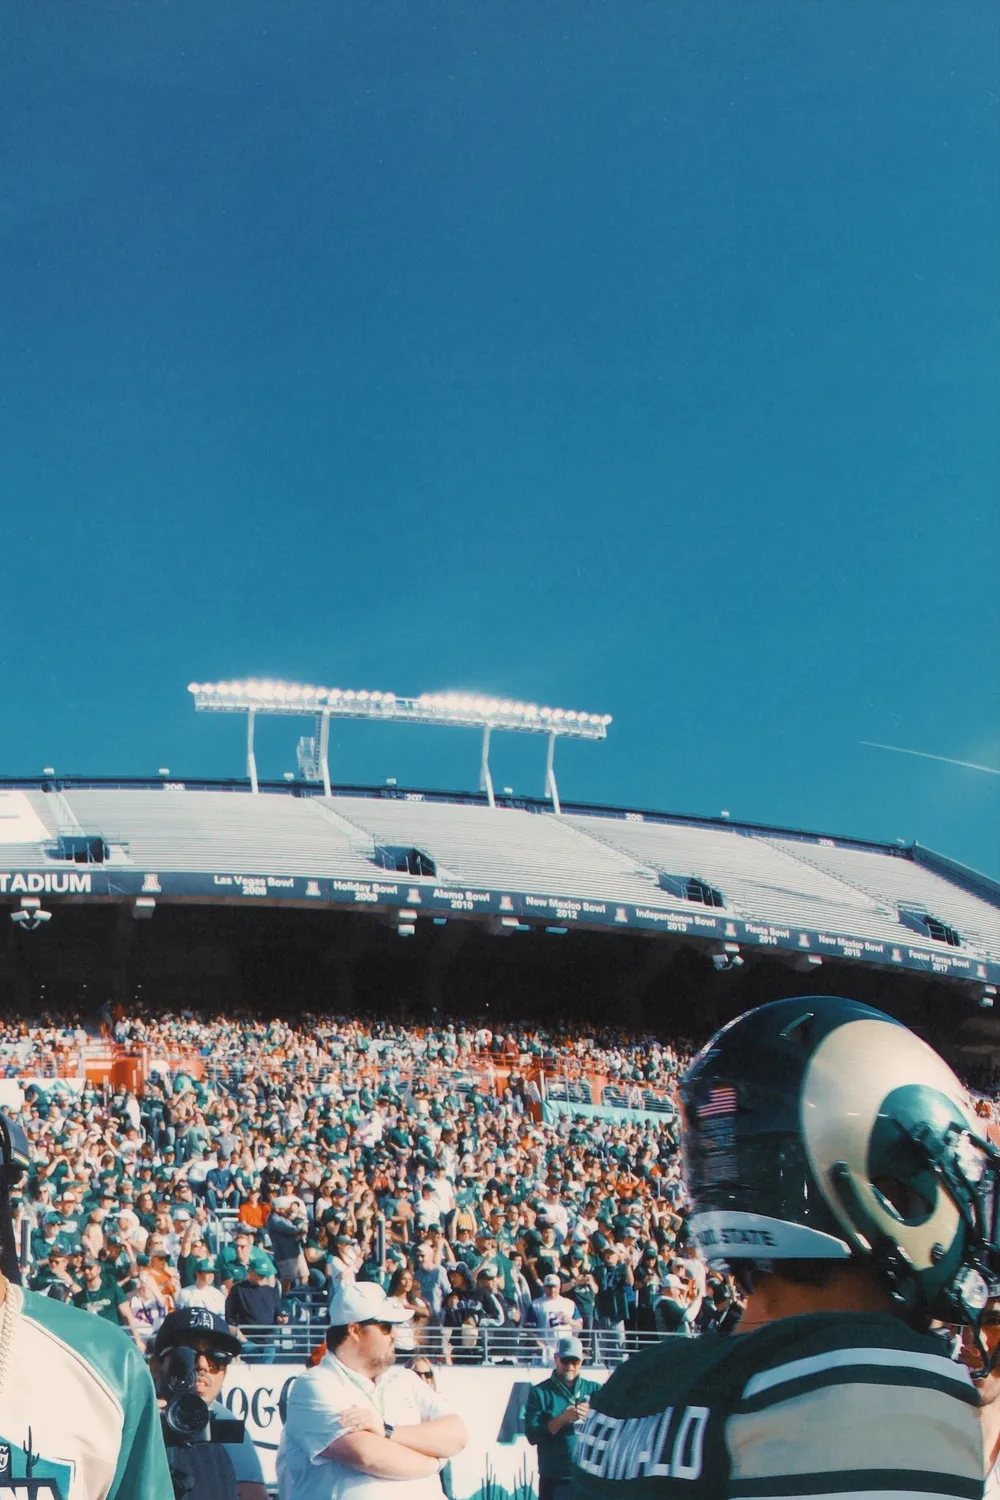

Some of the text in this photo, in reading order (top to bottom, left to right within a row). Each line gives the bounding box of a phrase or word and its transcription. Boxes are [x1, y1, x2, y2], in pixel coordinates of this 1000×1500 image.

[213, 875, 294, 888] Las Vegas Bowl
[333, 881, 398, 894] Holiday Bowl
[433, 889, 490, 902] Alamo Bowl
[451, 900, 473, 910] 2010
[525, 896, 606, 913] New Mexico Bowl
[556, 908, 578, 919] 2012
[635, 908, 716, 928] Independence Bowl
[667, 922, 687, 932] 2013
[745, 924, 790, 938] Fiesta Bowl
[758, 934, 778, 945] 2014
[818, 935, 884, 953] New Mexico Bowl
[908, 950, 930, 961] Foster
[952, 957, 969, 969] Bowl
[932, 962, 948, 973] 2017
